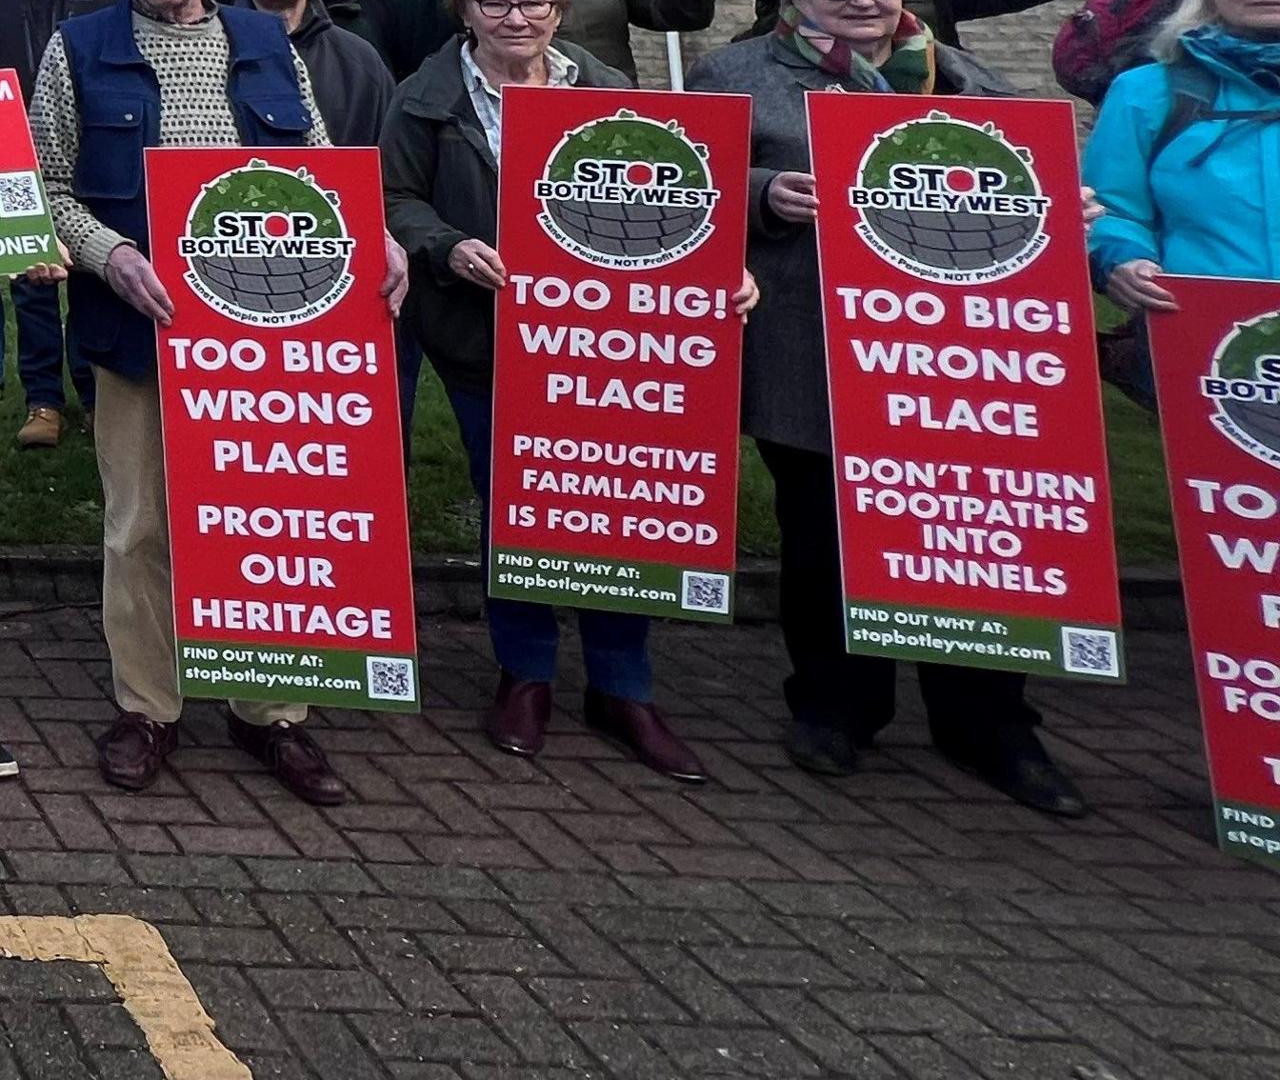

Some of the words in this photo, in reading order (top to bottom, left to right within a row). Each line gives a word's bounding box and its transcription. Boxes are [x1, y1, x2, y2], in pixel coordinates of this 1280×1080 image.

[510, 275, 610, 309] TOO
[630, 283, 727, 320] BIG!
[837, 287, 945, 326] TOO
[964, 295, 1071, 334] BIG!
[168, 339, 265, 371] TOO
[284, 341, 379, 375] BIG!
[518, 323, 717, 367] WRONG
[851, 339, 1066, 388] WRONG
[182, 388, 373, 425] WRONG
[547, 374, 684, 415] PLACE
[888, 394, 1038, 437] PLACE
[214, 439, 349, 477] PLACE
[514, 435, 716, 475] PRODUCTIVE
[522, 468, 705, 507] FARMLAND
[845, 456, 968, 491] DON'T
[985, 466, 1095, 503] TURN
[198, 504, 374, 544] PROTECT
[508, 505, 535, 527] IS
[548, 509, 611, 536] FOR
[623, 517, 718, 546] FOOD
[856, 488, 1088, 534] FOOTPATHS
[922, 525, 1021, 558] INTO
[241, 554, 336, 589] OUR
[498, 553, 533, 569] FIND
[538, 557, 571, 572] OUT
[574, 561, 611, 577] WHY
[617, 566, 640, 580] AT:
[498, 572, 677, 602] stopbotleywest.com
[883, 551, 1067, 596] TUNNELS
[193, 598, 392, 640] HERITAGE
